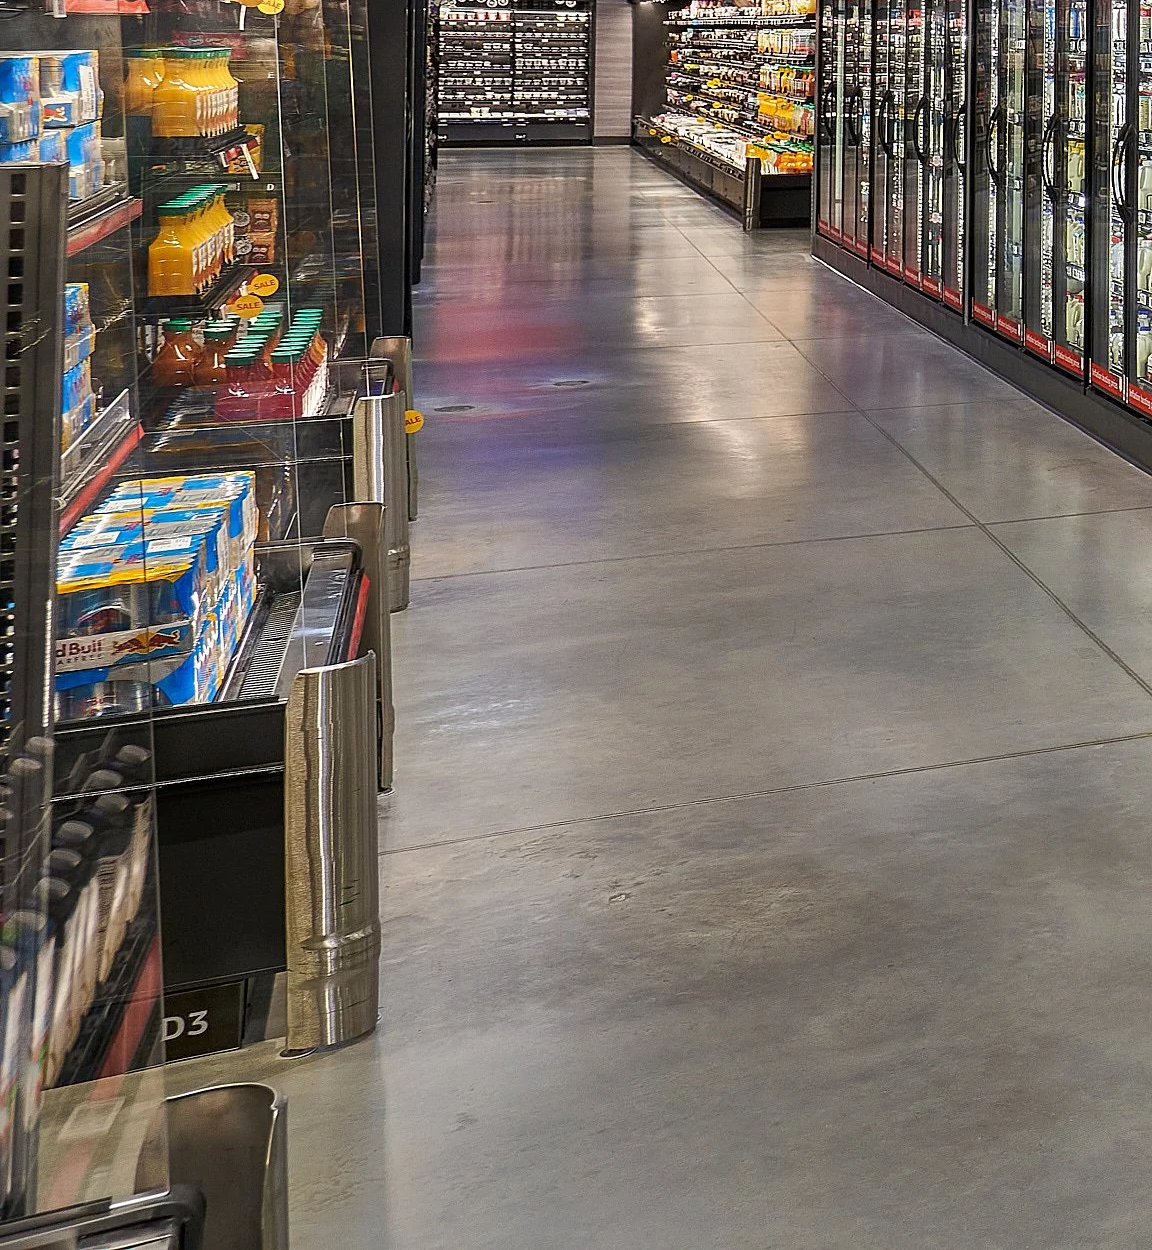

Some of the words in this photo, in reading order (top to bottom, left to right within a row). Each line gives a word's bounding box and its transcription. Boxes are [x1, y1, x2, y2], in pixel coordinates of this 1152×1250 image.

[253, 279, 276, 290] SALE
[236, 301, 261, 311] SALE
[405, 415, 422, 425] ALE
